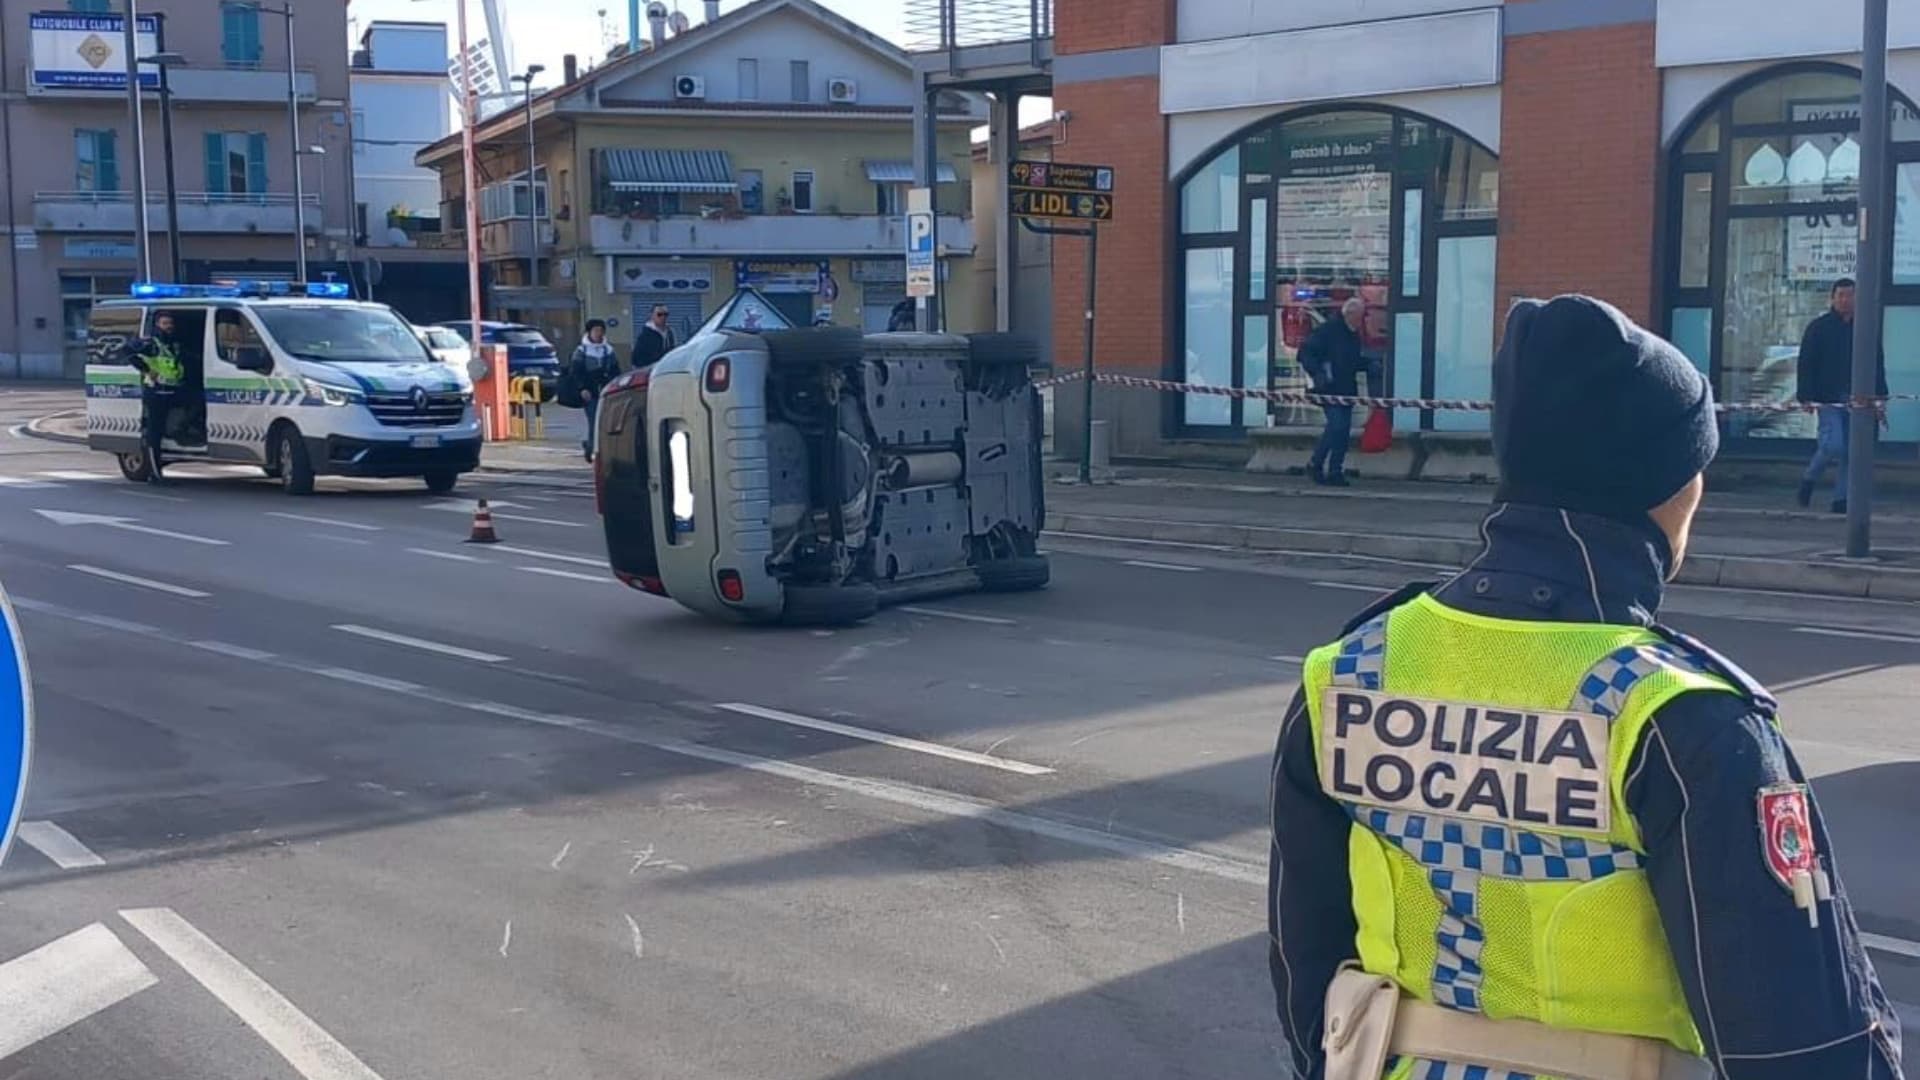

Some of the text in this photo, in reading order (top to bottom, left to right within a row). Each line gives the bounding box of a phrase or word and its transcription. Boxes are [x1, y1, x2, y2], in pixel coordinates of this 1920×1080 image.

[32, 17, 87, 30] AUTOMOBILE
[90, 19, 111, 31] CLUB
[1030, 192, 1073, 215] LIDL
[911, 215, 930, 251] P
[225, 390, 263, 404] LOCALE
[1334, 692, 1598, 770] POLIZIA
[1332, 747, 1599, 829] LOCALE
